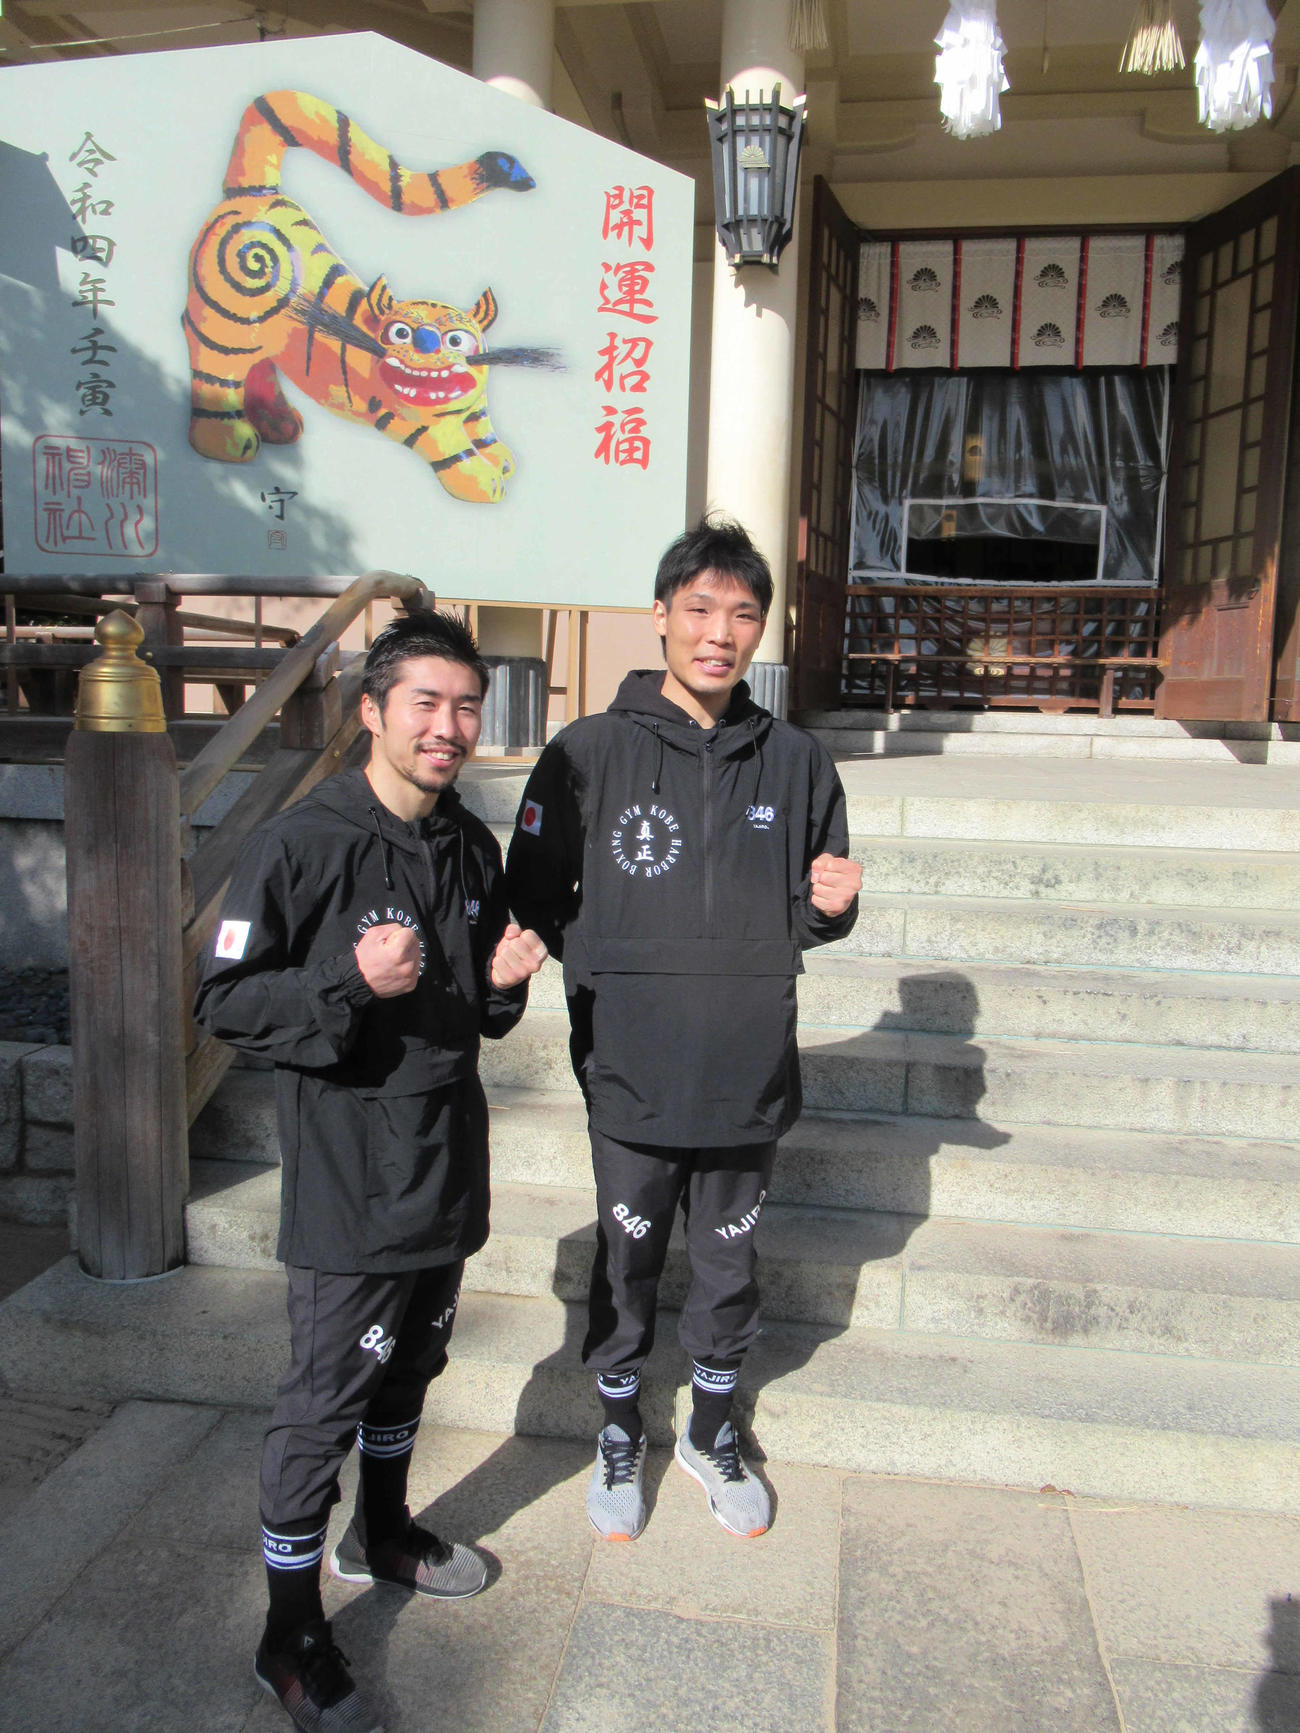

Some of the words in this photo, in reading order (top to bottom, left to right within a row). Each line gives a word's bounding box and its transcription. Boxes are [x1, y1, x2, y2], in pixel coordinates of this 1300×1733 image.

[69, 131, 118, 417] 令和四年壬寅
[594, 184, 659, 470] 開運招福
[619, 804, 641, 825] GYM
[650, 804, 679, 832] KOBE
[611, 830, 637, 875] BOXING
[634, 820, 655, 861] 真正
[645, 839, 682, 877] HARBOR
[612, 1202, 651, 1239] 846
